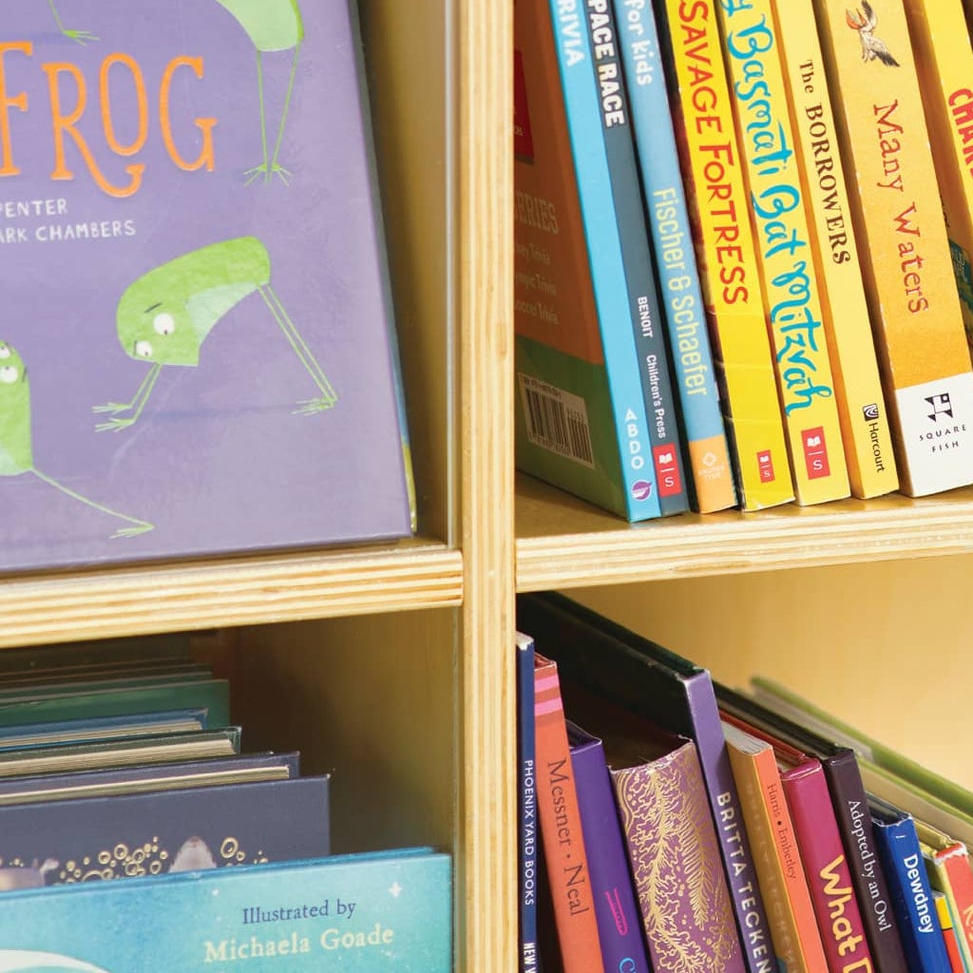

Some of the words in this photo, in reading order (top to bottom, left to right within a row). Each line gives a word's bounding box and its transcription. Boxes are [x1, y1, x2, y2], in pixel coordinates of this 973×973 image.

[631, 40, 655, 87] kids
[678, 0, 723, 135] SAVAGE
[727, 13, 793, 176] Basmati
[799, 59, 816, 94] The
[0, 40, 218, 198] FROG
[598, 62, 626, 128] RACE
[805, 102, 851, 265] BORROWERS
[873, 99, 904, 192] Many
[893, 201, 929, 314] Waters
[35, 220, 137, 242] CHAMBERS
[653, 187, 686, 270] Fischer
[699, 140, 749, 305] FORTRESS
[751, 184, 807, 259] Bat
[668, 275, 692, 292] &
[637, 296, 653, 338] BENOIT
[671, 296, 708, 397] Schaefer
[770, 260, 832, 417] Mitzvah
[646, 354, 662, 407] Children's
[654, 408, 667, 439] Press
[624, 408, 645, 470] ABDO
[868, 422, 885, 473] Harcourt
[919, 424, 967, 441] SQUARE
[931, 440, 960, 453] FISH
[523, 760, 536, 819] PHOENIX
[524, 822, 537, 855] YARD
[547, 758, 573, 847] Messner
[564, 862, 590, 916] Neal
[717, 792, 747, 877] BRITTA
[767, 783, 782, 818] Harris
[777, 828, 797, 879] Emberley
[848, 800, 874, 863] Adopted
[524, 860, 536, 906] BOOKS
[862, 858, 877, 878] by
[868, 881, 881, 900] an
[903, 854, 935, 935] Dewdney
[243, 902, 330, 925] Illustrated
[335, 900, 356, 918] by
[819, 854, 863, 957] What
[874, 900, 892, 932] Owl
[205, 935, 310, 963] Michaela
[321, 922, 394, 952] Goade
[523, 942, 537, 965] NEW
